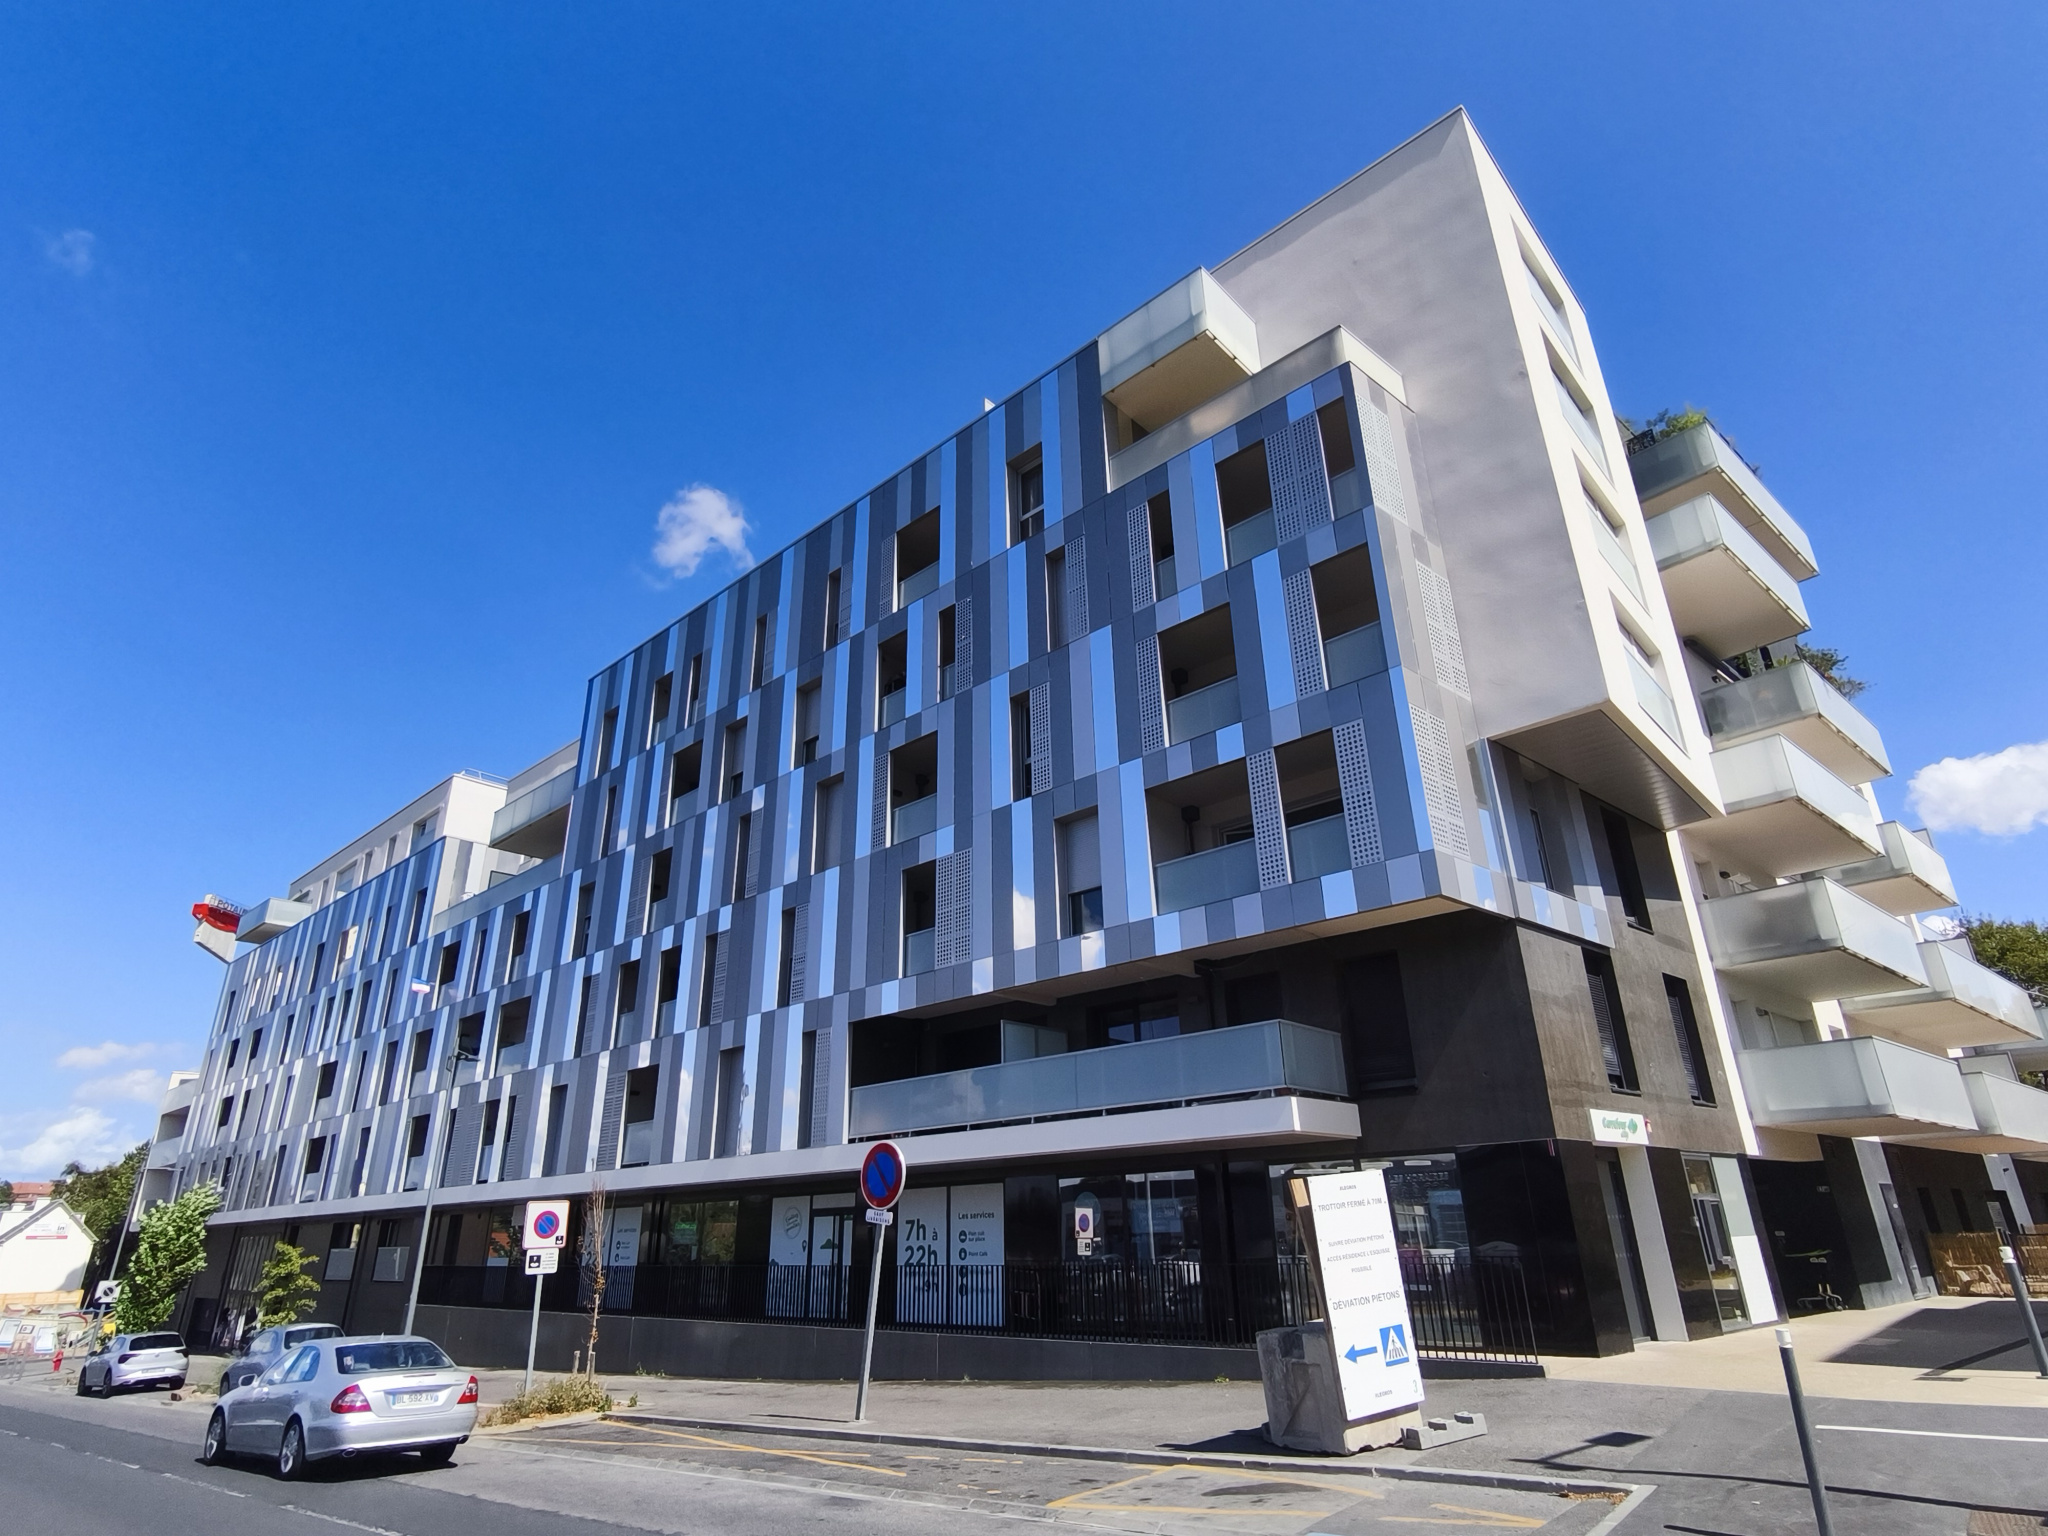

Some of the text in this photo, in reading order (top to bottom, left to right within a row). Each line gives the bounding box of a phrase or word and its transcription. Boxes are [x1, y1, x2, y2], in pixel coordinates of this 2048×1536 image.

[1318, 1201, 1346, 1212] TROTTOIR
[1347, 1199, 1365, 1209] FERMÉ
[970, 1211, 994, 1219] services
[905, 1218, 938, 1241] 7h à
[905, 1244, 938, 1267] 22h
[1333, 1296, 1371, 1311] DÉVIATION
